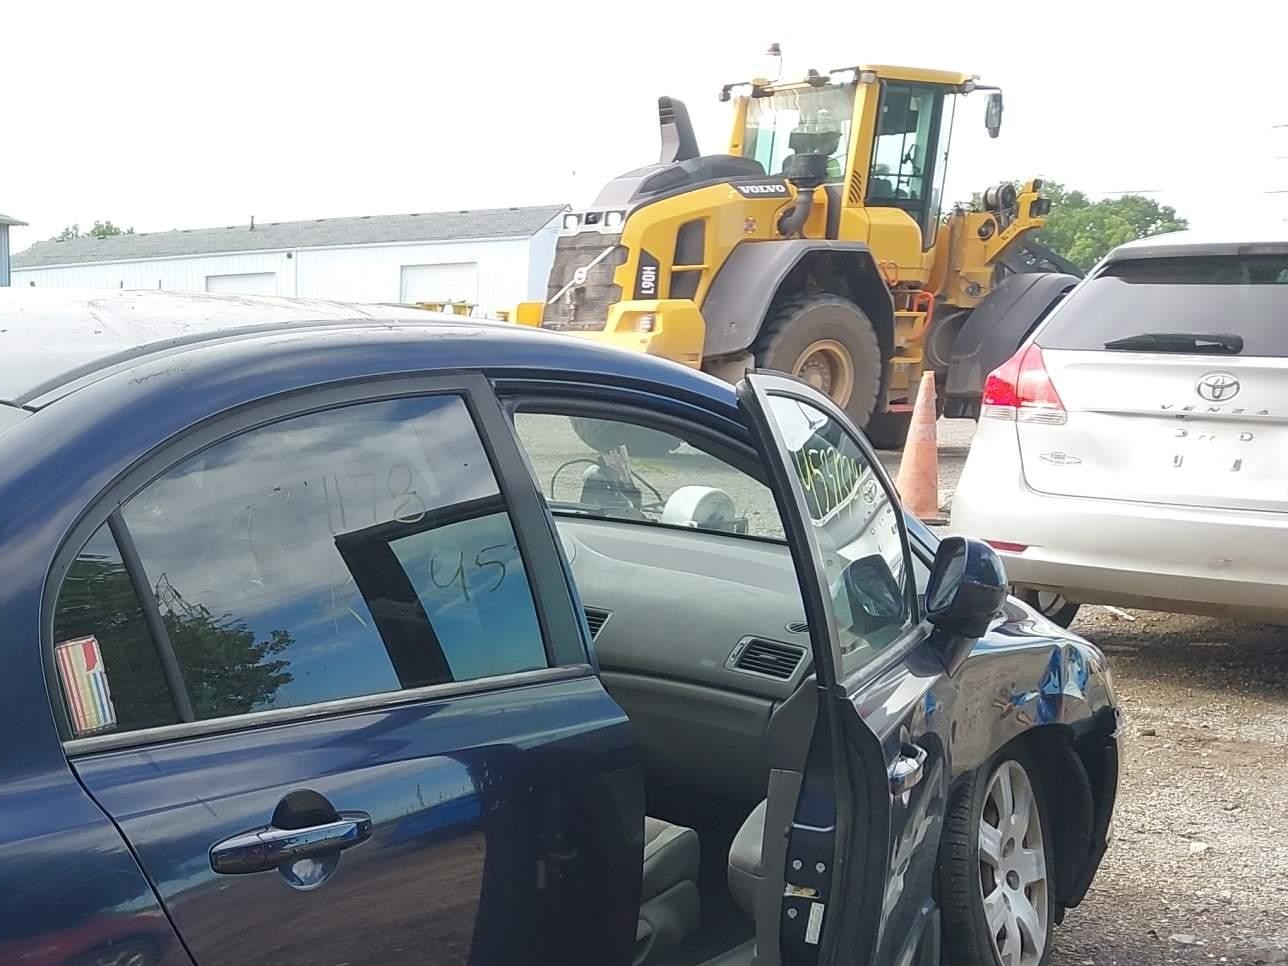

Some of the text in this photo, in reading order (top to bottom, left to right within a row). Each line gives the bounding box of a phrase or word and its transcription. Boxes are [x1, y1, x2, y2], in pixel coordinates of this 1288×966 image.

[737, 184, 786, 194] VOLVO
[640, 266, 656, 294] L90H
[430, 544, 520, 602] 45
